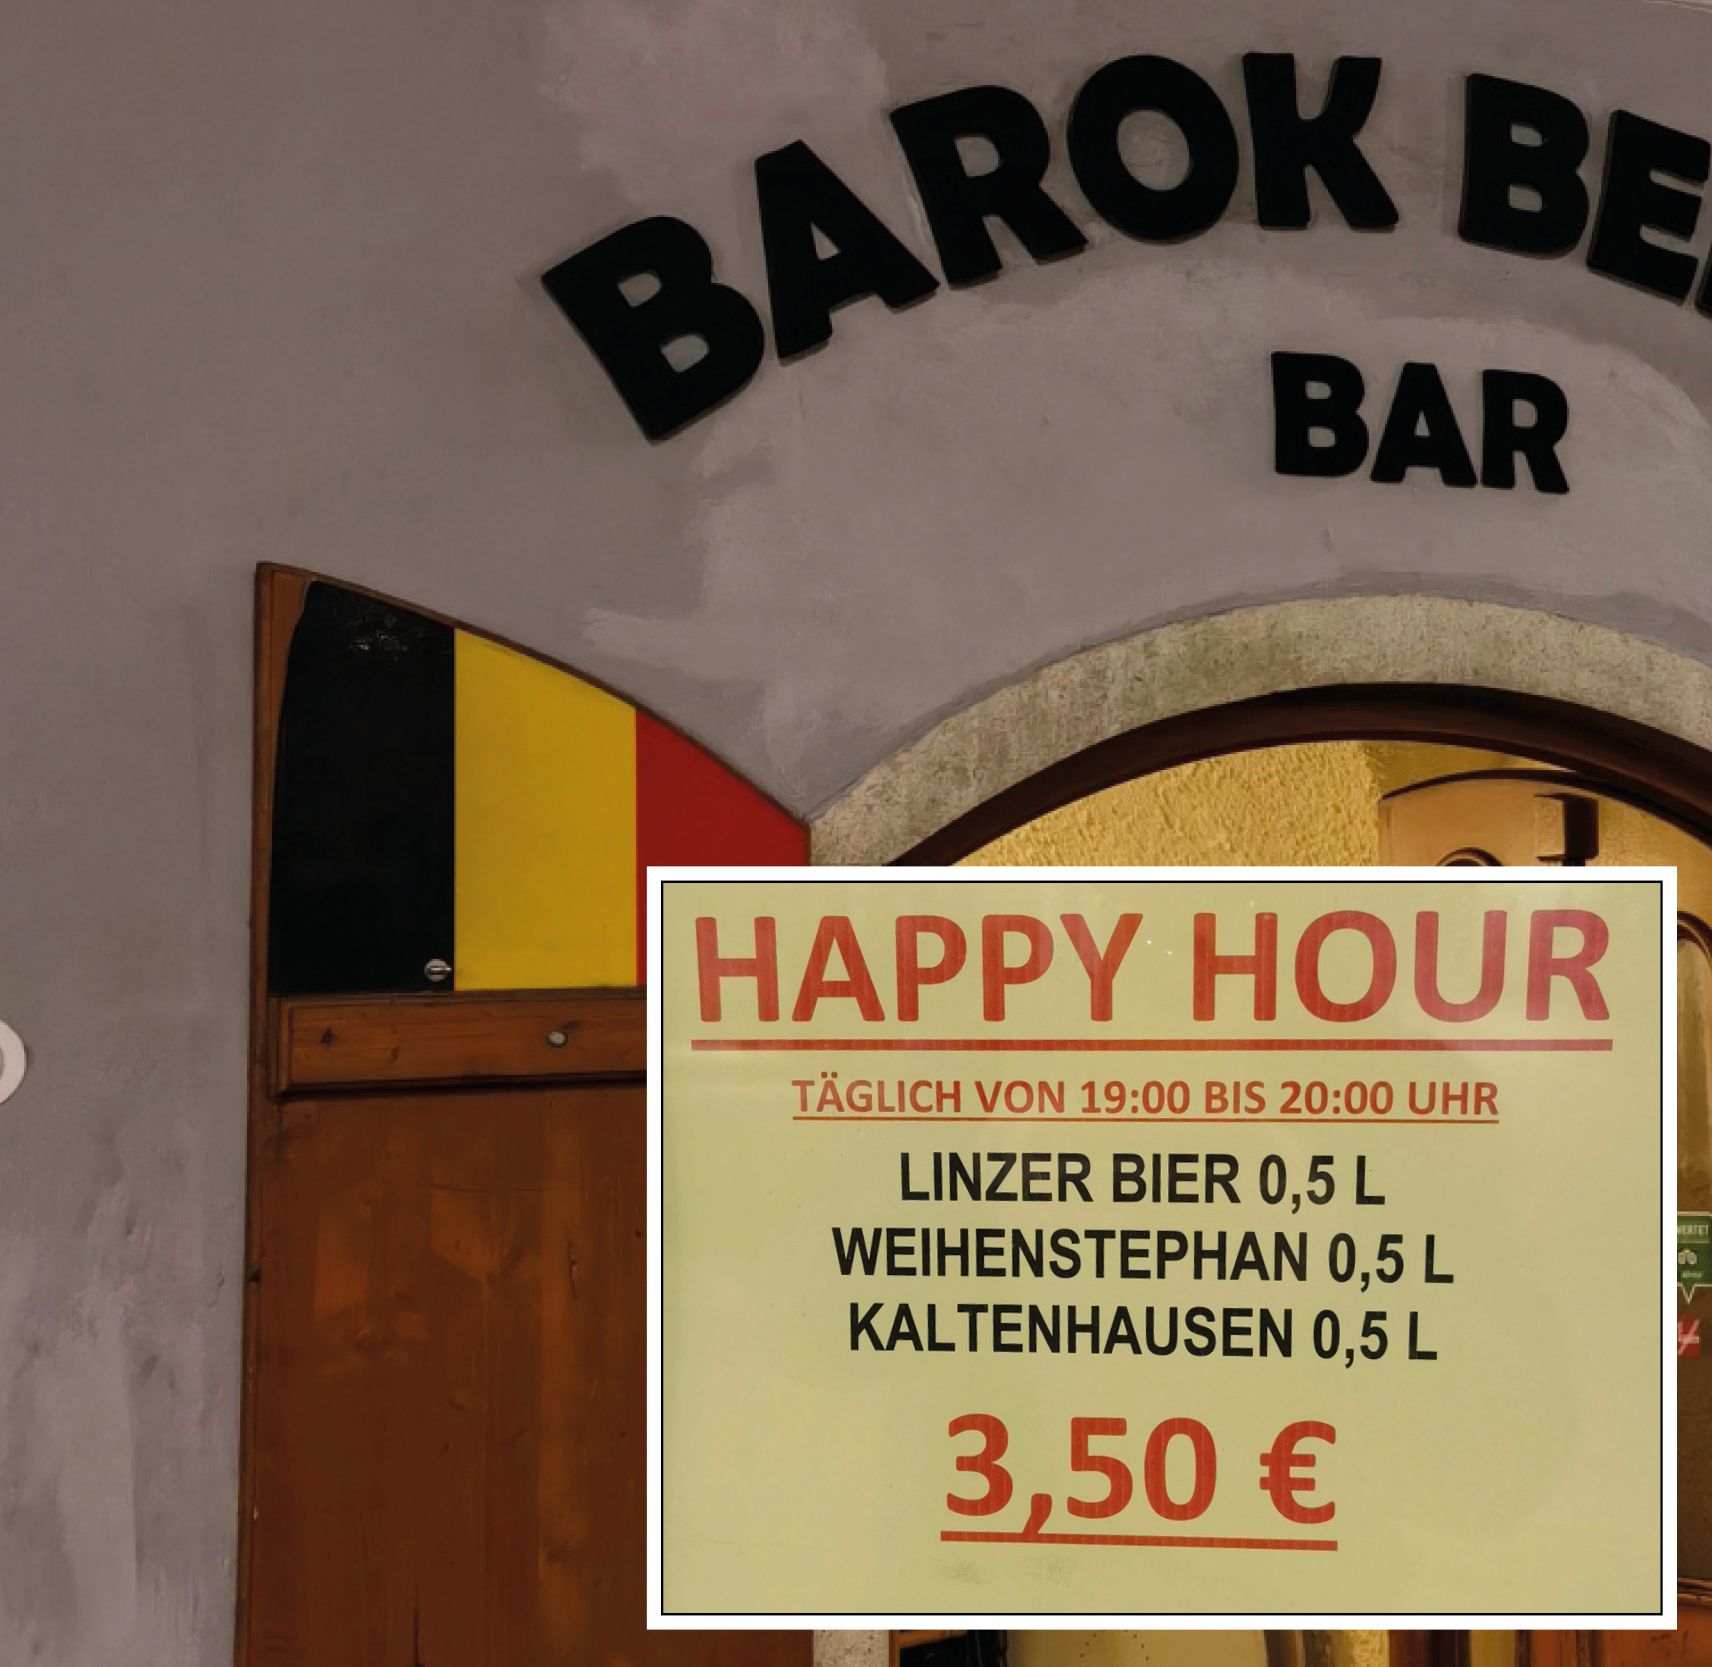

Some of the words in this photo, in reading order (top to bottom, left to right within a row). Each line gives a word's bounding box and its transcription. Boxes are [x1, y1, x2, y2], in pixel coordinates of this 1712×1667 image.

[541, 52, 1399, 443] BAROK
[1271, 352, 1570, 495] BAR
[696, 914, 1143, 1023] HAPPY
[1193, 911, 1609, 1022] HOUR
[794, 1073, 961, 1114] TÄGLICH
[976, 1081, 1065, 1114] VON
[1083, 1081, 1190, 1115] 19:00
[1204, 1082, 1265, 1115] BIS
[1280, 1082, 1393, 1116] 20:00
[1408, 1082, 1498, 1116] UHR
[901, 1152, 1094, 1203] LINZER
[1113, 1154, 1241, 1204] BIER
[1260, 1155, 1335, 1214] 0,5
[1355, 1156, 1386, 1205] L
[832, 1228, 1307, 1282] WEIHENSTEPHAN
[1329, 1233, 1404, 1290] 0,5
[1424, 1235, 1454, 1284] L
[850, 1303, 1293, 1358] KALTENHAUSEN
[1313, 1310, 1388, 1368] 0,5
[1408, 1312, 1438, 1361] L
[946, 1413, 1217, 1534] 3,50
[1259, 1420, 1336, 1525] €
